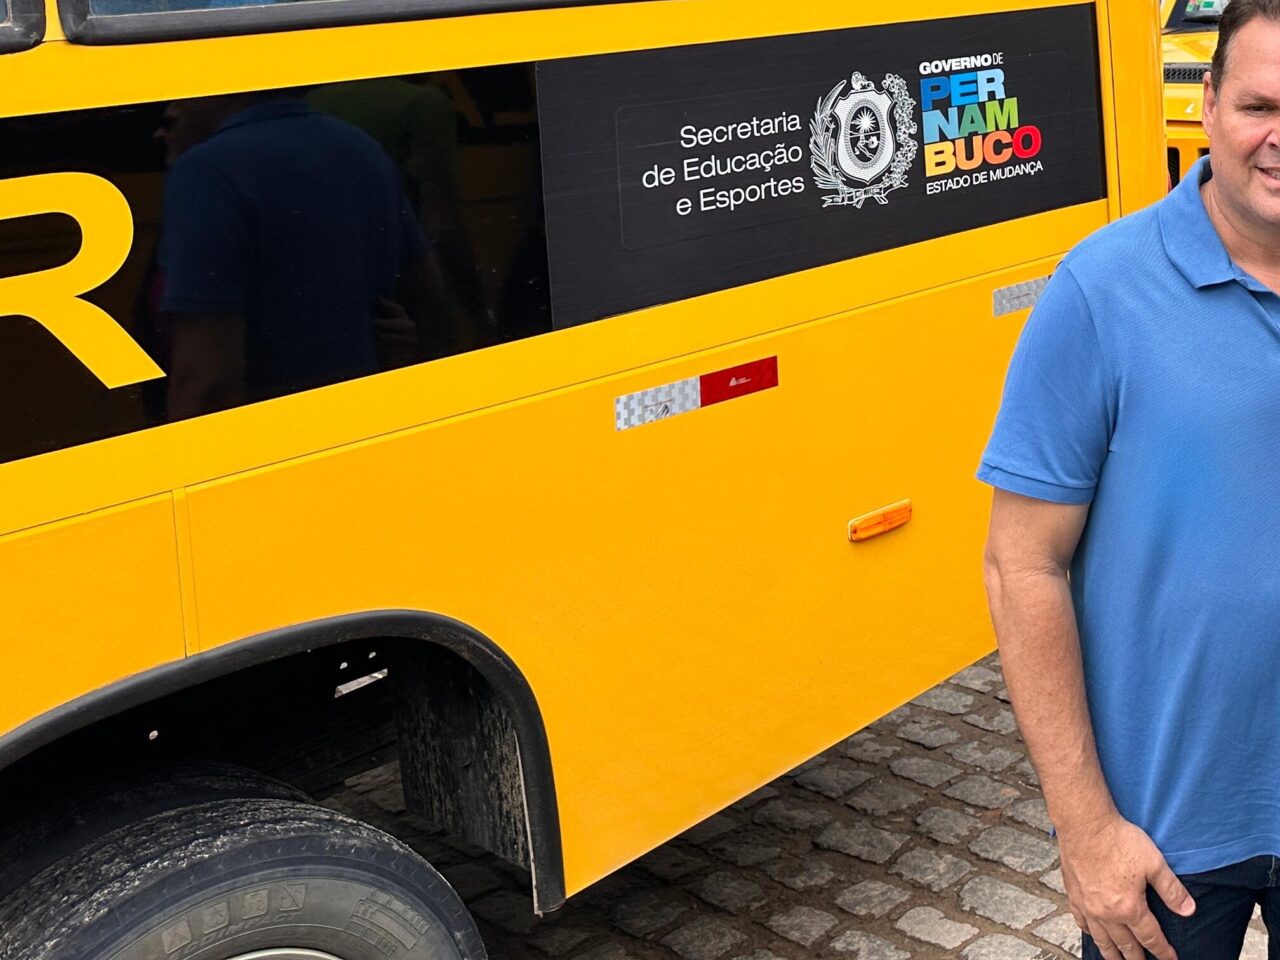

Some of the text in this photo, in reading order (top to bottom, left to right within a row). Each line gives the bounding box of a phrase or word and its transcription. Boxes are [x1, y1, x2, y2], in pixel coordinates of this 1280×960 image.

[919, 52, 1004, 75] GOVERNO DE
[920, 68, 1006, 112] PER
[680, 111, 802, 148] Secretaria
[922, 96, 1019, 144] NAM
[642, 143, 803, 189] de Educação
[924, 125, 1042, 178] BUCO
[676, 175, 805, 216] e Esportes
[926, 160, 1044, 195] ESTADO DE MUDANÇA
